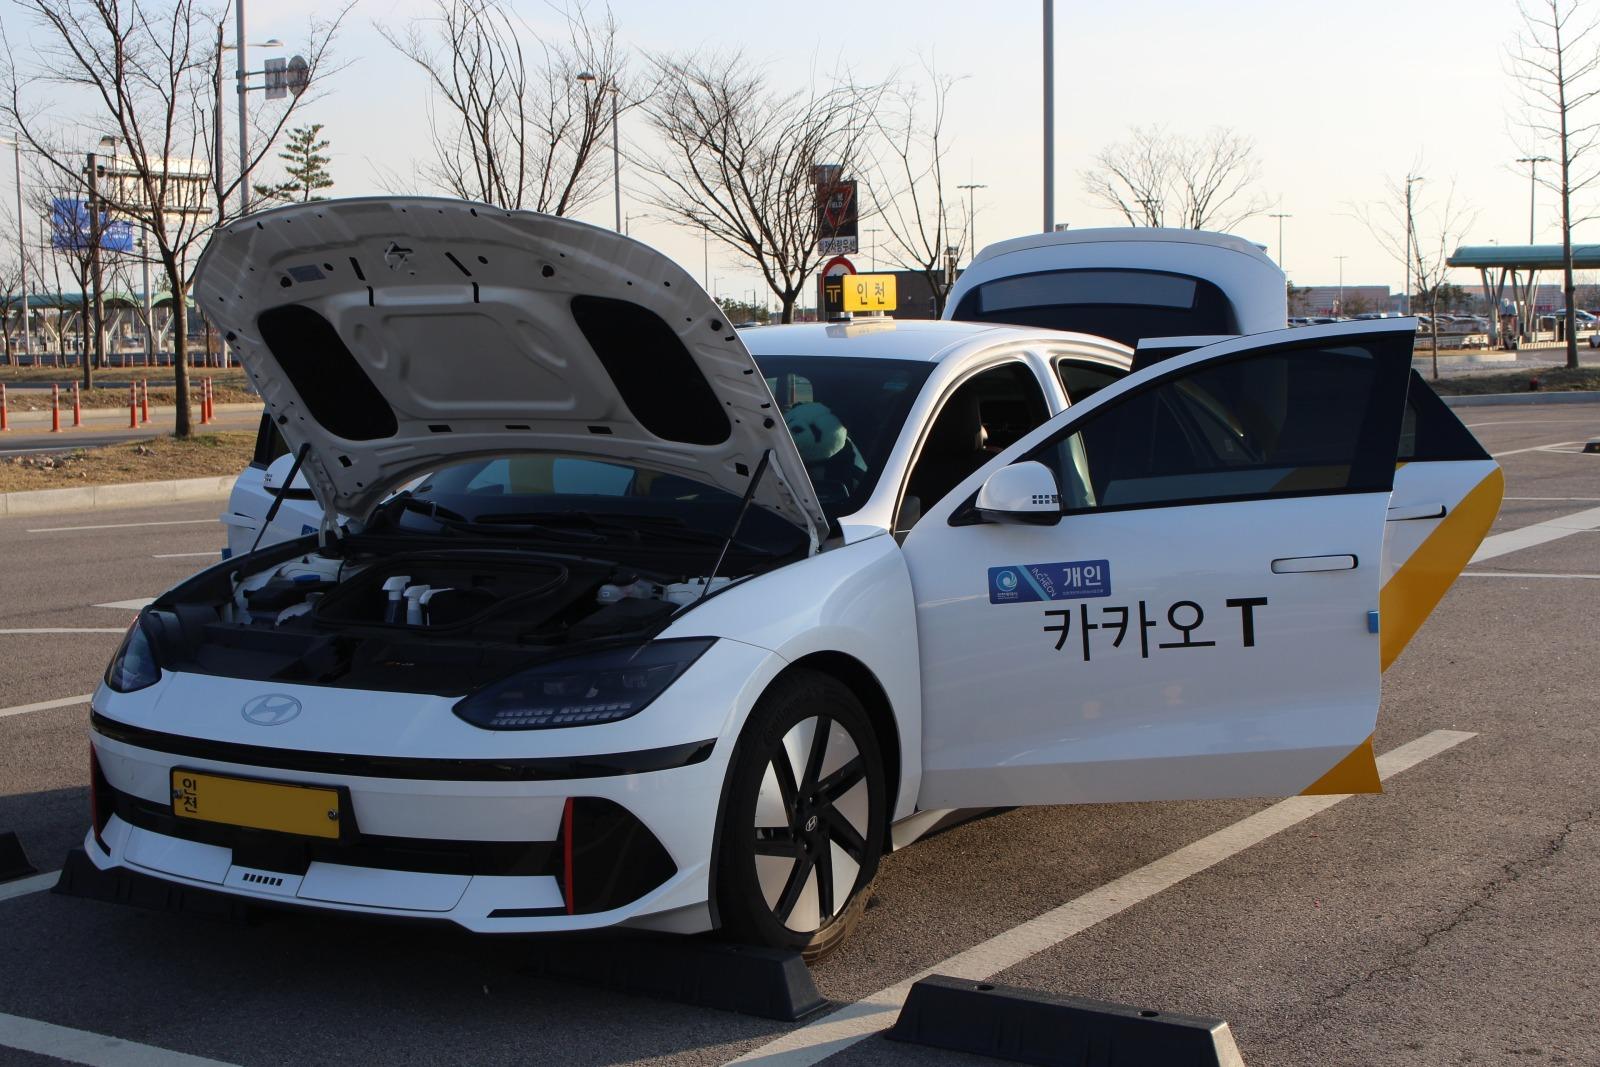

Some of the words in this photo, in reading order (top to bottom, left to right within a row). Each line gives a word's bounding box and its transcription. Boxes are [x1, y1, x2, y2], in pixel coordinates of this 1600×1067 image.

[857, 281, 885, 305] 인천
[1062, 565, 1102, 588] 개인
[1043, 600, 1216, 661] 카카오
[1226, 597, 1268, 647] T
[183, 778, 198, 813] 인천
